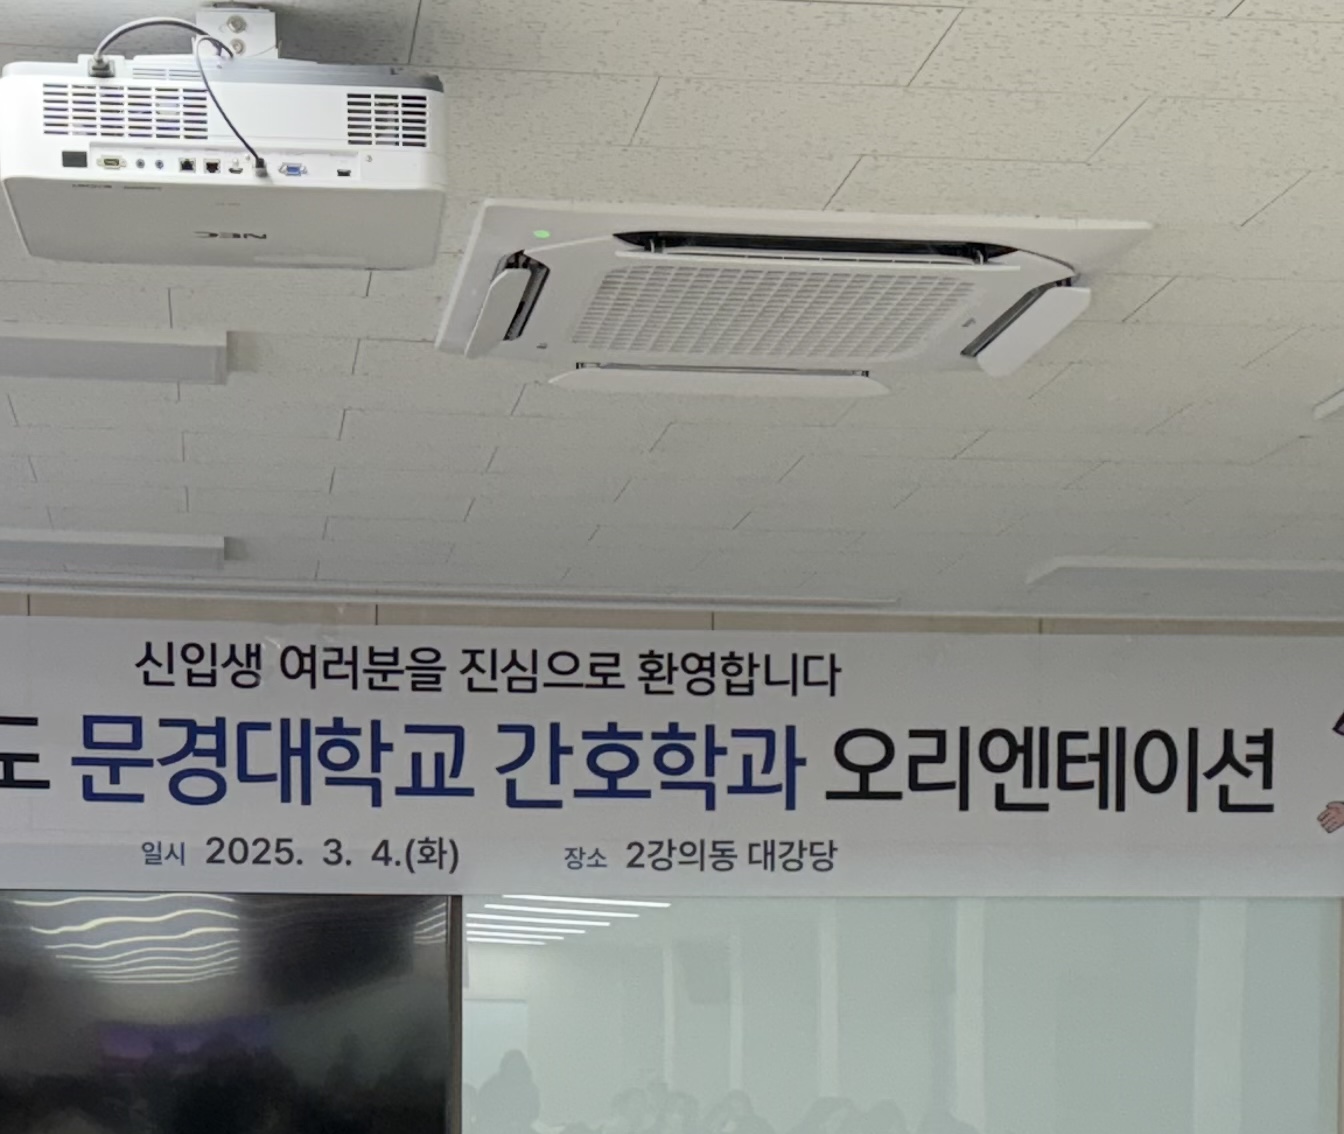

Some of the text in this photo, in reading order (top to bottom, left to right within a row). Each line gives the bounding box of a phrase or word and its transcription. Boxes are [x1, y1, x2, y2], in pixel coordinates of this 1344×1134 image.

[135, 641, 842, 697] 신입생 여러분을 진심으로 환영합니다
[71, 715, 475, 808] 문경대학교
[496, 721, 807, 811] 간호학과
[825, 726, 1275, 813] 오리엔테이션
[141, 836, 460, 875] 일시 2025. 3. 4.(화)
[565, 838, 839, 873] 장소 2강의동 대강당
